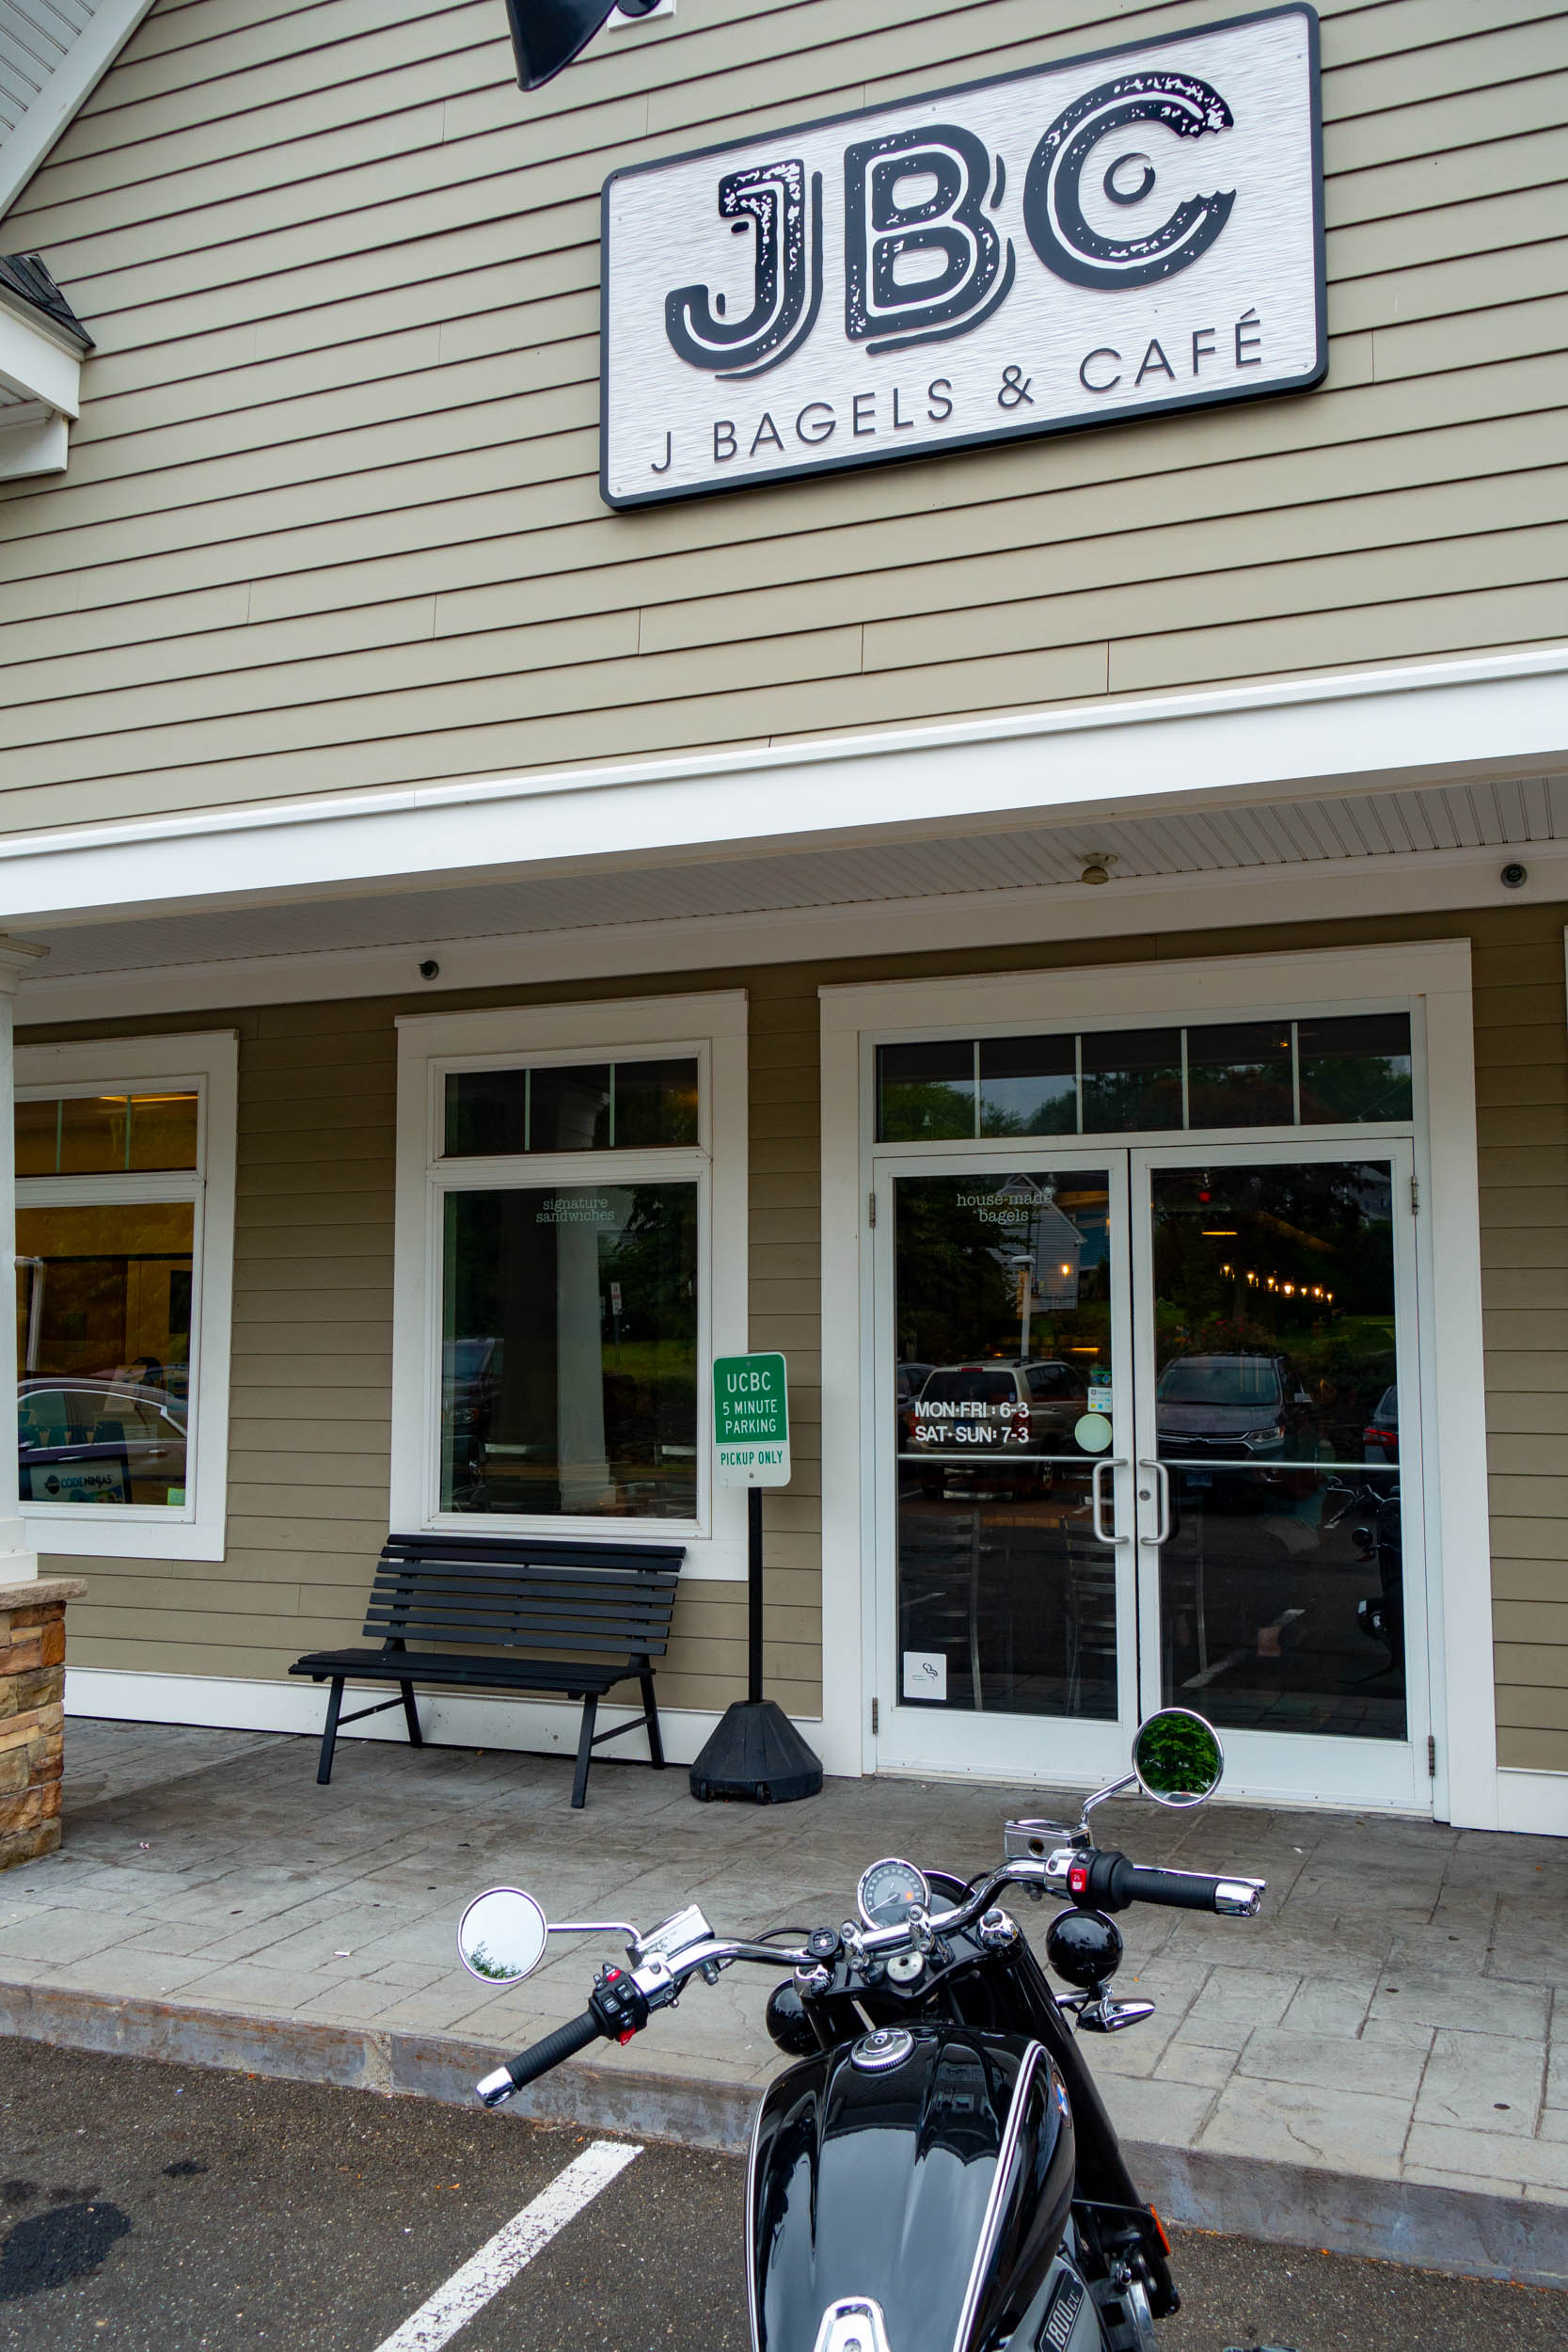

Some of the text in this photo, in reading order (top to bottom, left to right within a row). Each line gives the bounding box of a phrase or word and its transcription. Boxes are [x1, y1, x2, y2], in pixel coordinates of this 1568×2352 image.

[664, 70, 1237, 380] JBC
[651, 307, 1262, 472] J BAGELS & CAFÉ
[543, 1198, 609, 1213] signature
[956, 1193, 1053, 1206] house-made
[535, 1209, 615, 1223] sandwiches
[978, 1209, 1029, 1225] bagels
[727, 1372, 771, 1392] UCBC
[722, 1399, 778, 1415] 5 MINUTE
[725, 1419, 776, 1435] PARKING
[1001, 1427, 1029, 1443] 7-3
[721, 1450, 783, 1466] PICKUP ONLY
[60, 1477, 83, 1488] CODE
[84, 1475, 112, 1487] NINJAS
